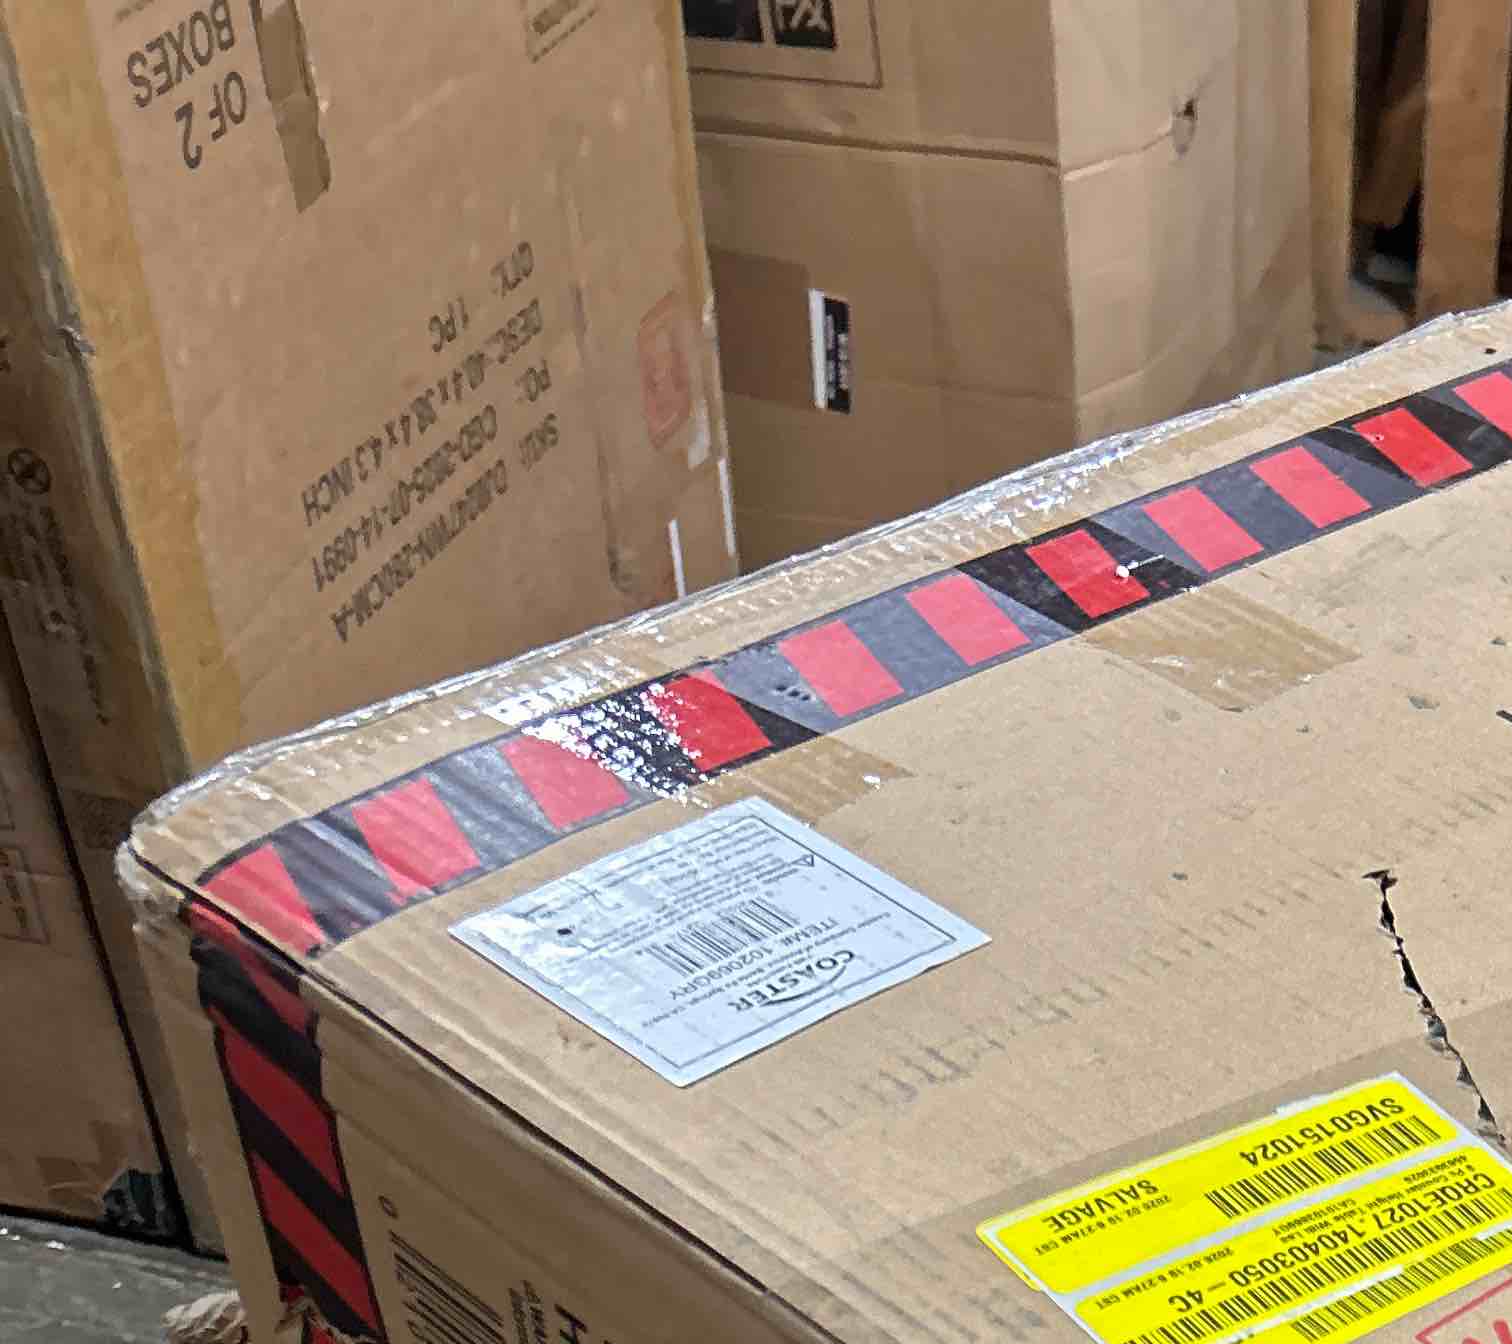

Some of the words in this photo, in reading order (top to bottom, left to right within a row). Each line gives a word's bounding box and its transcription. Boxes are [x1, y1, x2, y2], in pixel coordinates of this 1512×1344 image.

[128, 0, 236, 108] BOXES
[175, 102, 202, 170] 2
[209, 72, 246, 142] OF
[429, 304, 456, 352] PC
[302, 457, 354, 526] INCH
[728, 950, 855, 1011] COASTER
[1240, 1098, 1403, 1166] SVG0151024
[1043, 1180, 1158, 1232] SALVAGE
[1229, 1173, 1495, 1299] CRQE1027.140403050
[1168, 1291, 1203, 1312] 4C
